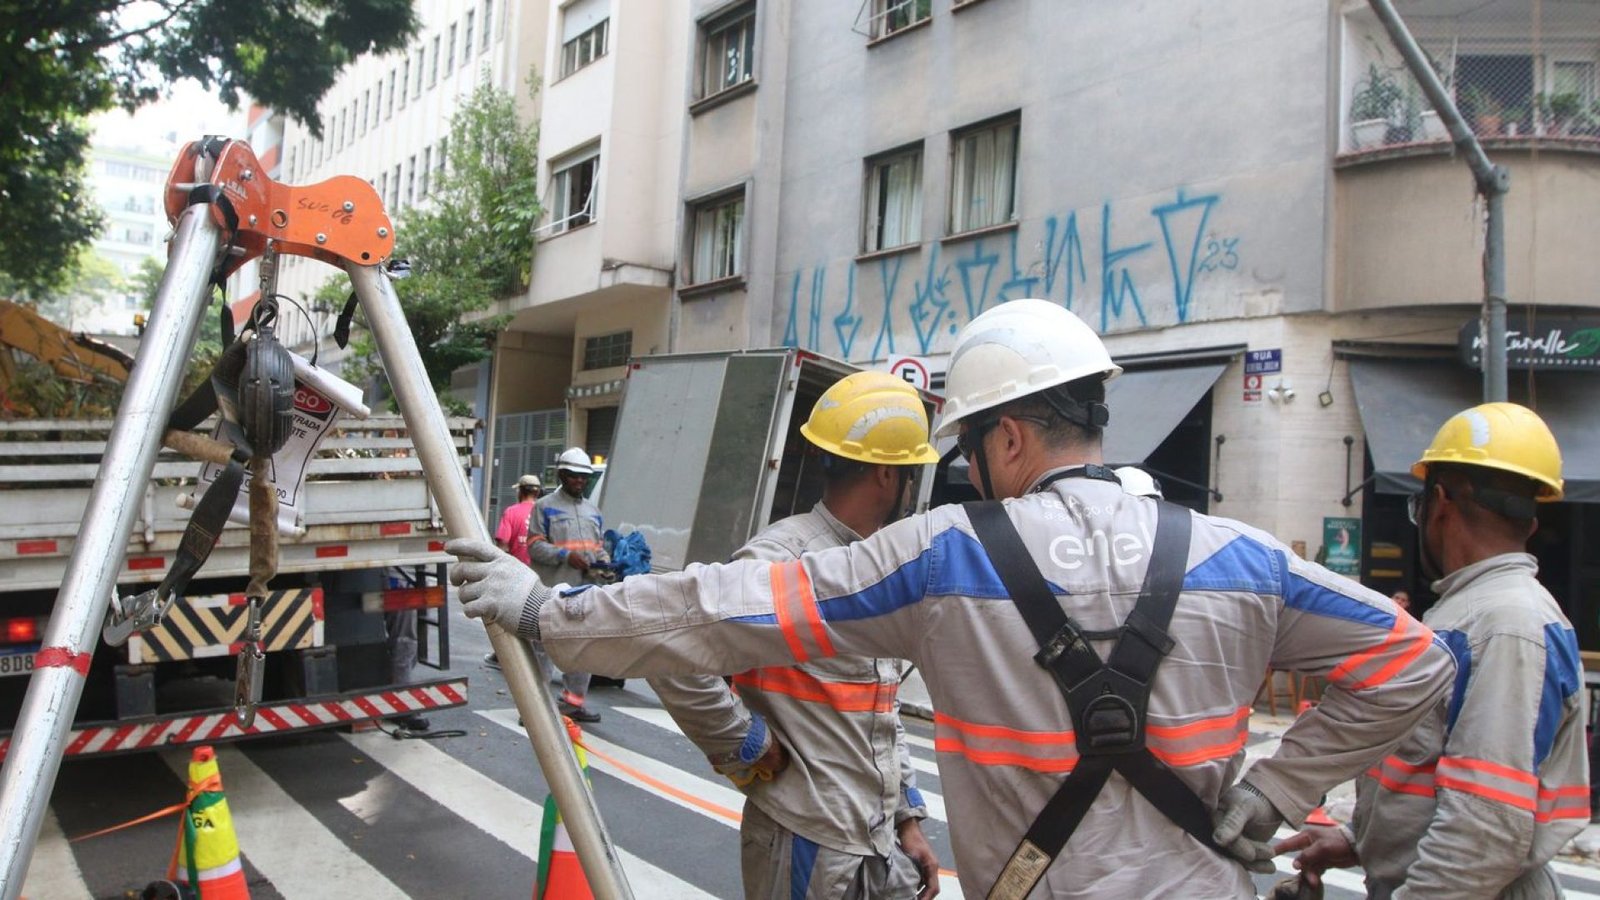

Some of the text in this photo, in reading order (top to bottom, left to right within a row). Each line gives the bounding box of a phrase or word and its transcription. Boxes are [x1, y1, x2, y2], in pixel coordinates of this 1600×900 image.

[1252, 351, 1273, 361] RUA
[294, 389, 320, 409] GO
[292, 414, 322, 432] TRADA
[1049, 521, 1153, 570] enel
[0, 655, 34, 673] 8D8
[193, 816, 215, 829] GA
